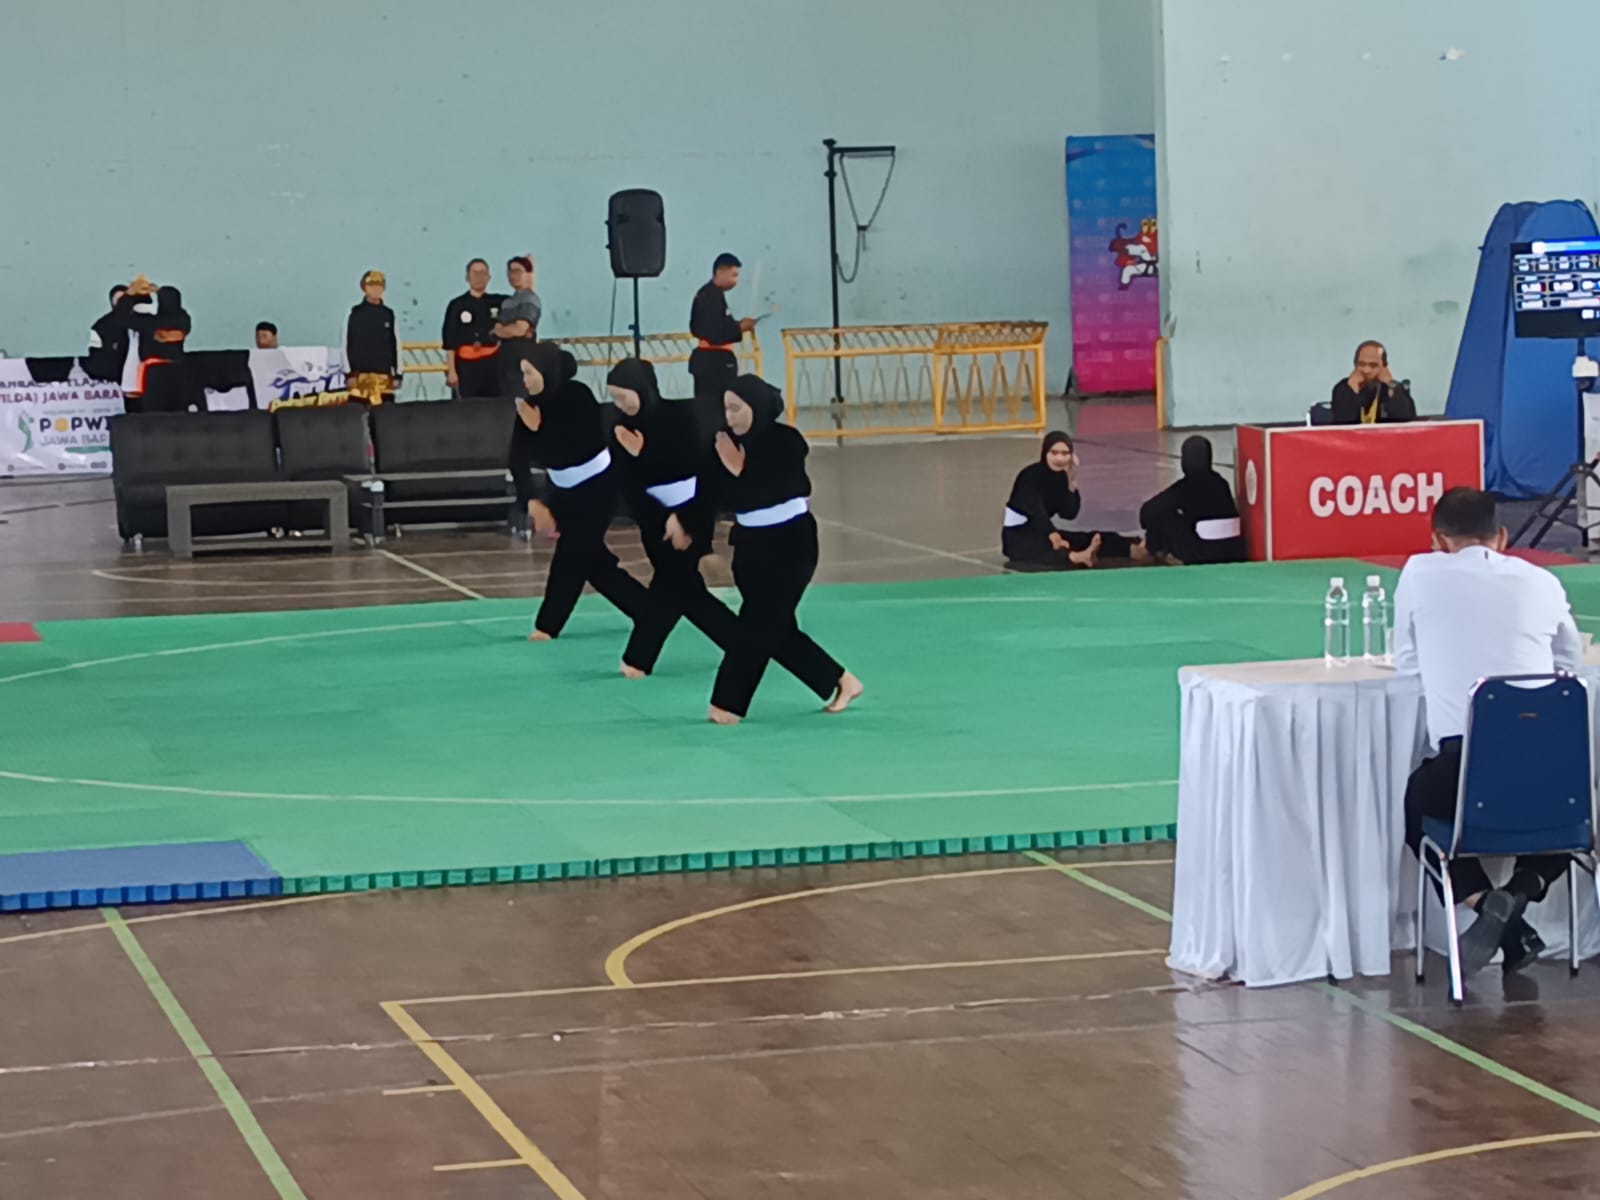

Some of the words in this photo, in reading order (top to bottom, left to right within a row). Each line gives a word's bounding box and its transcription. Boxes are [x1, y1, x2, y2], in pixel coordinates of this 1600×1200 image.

[42, 392, 79, 404] JAWA
[84, 389, 120, 400] BARA
[40, 416, 111, 432] POPWI
[1309, 472, 1443, 518] COACH
